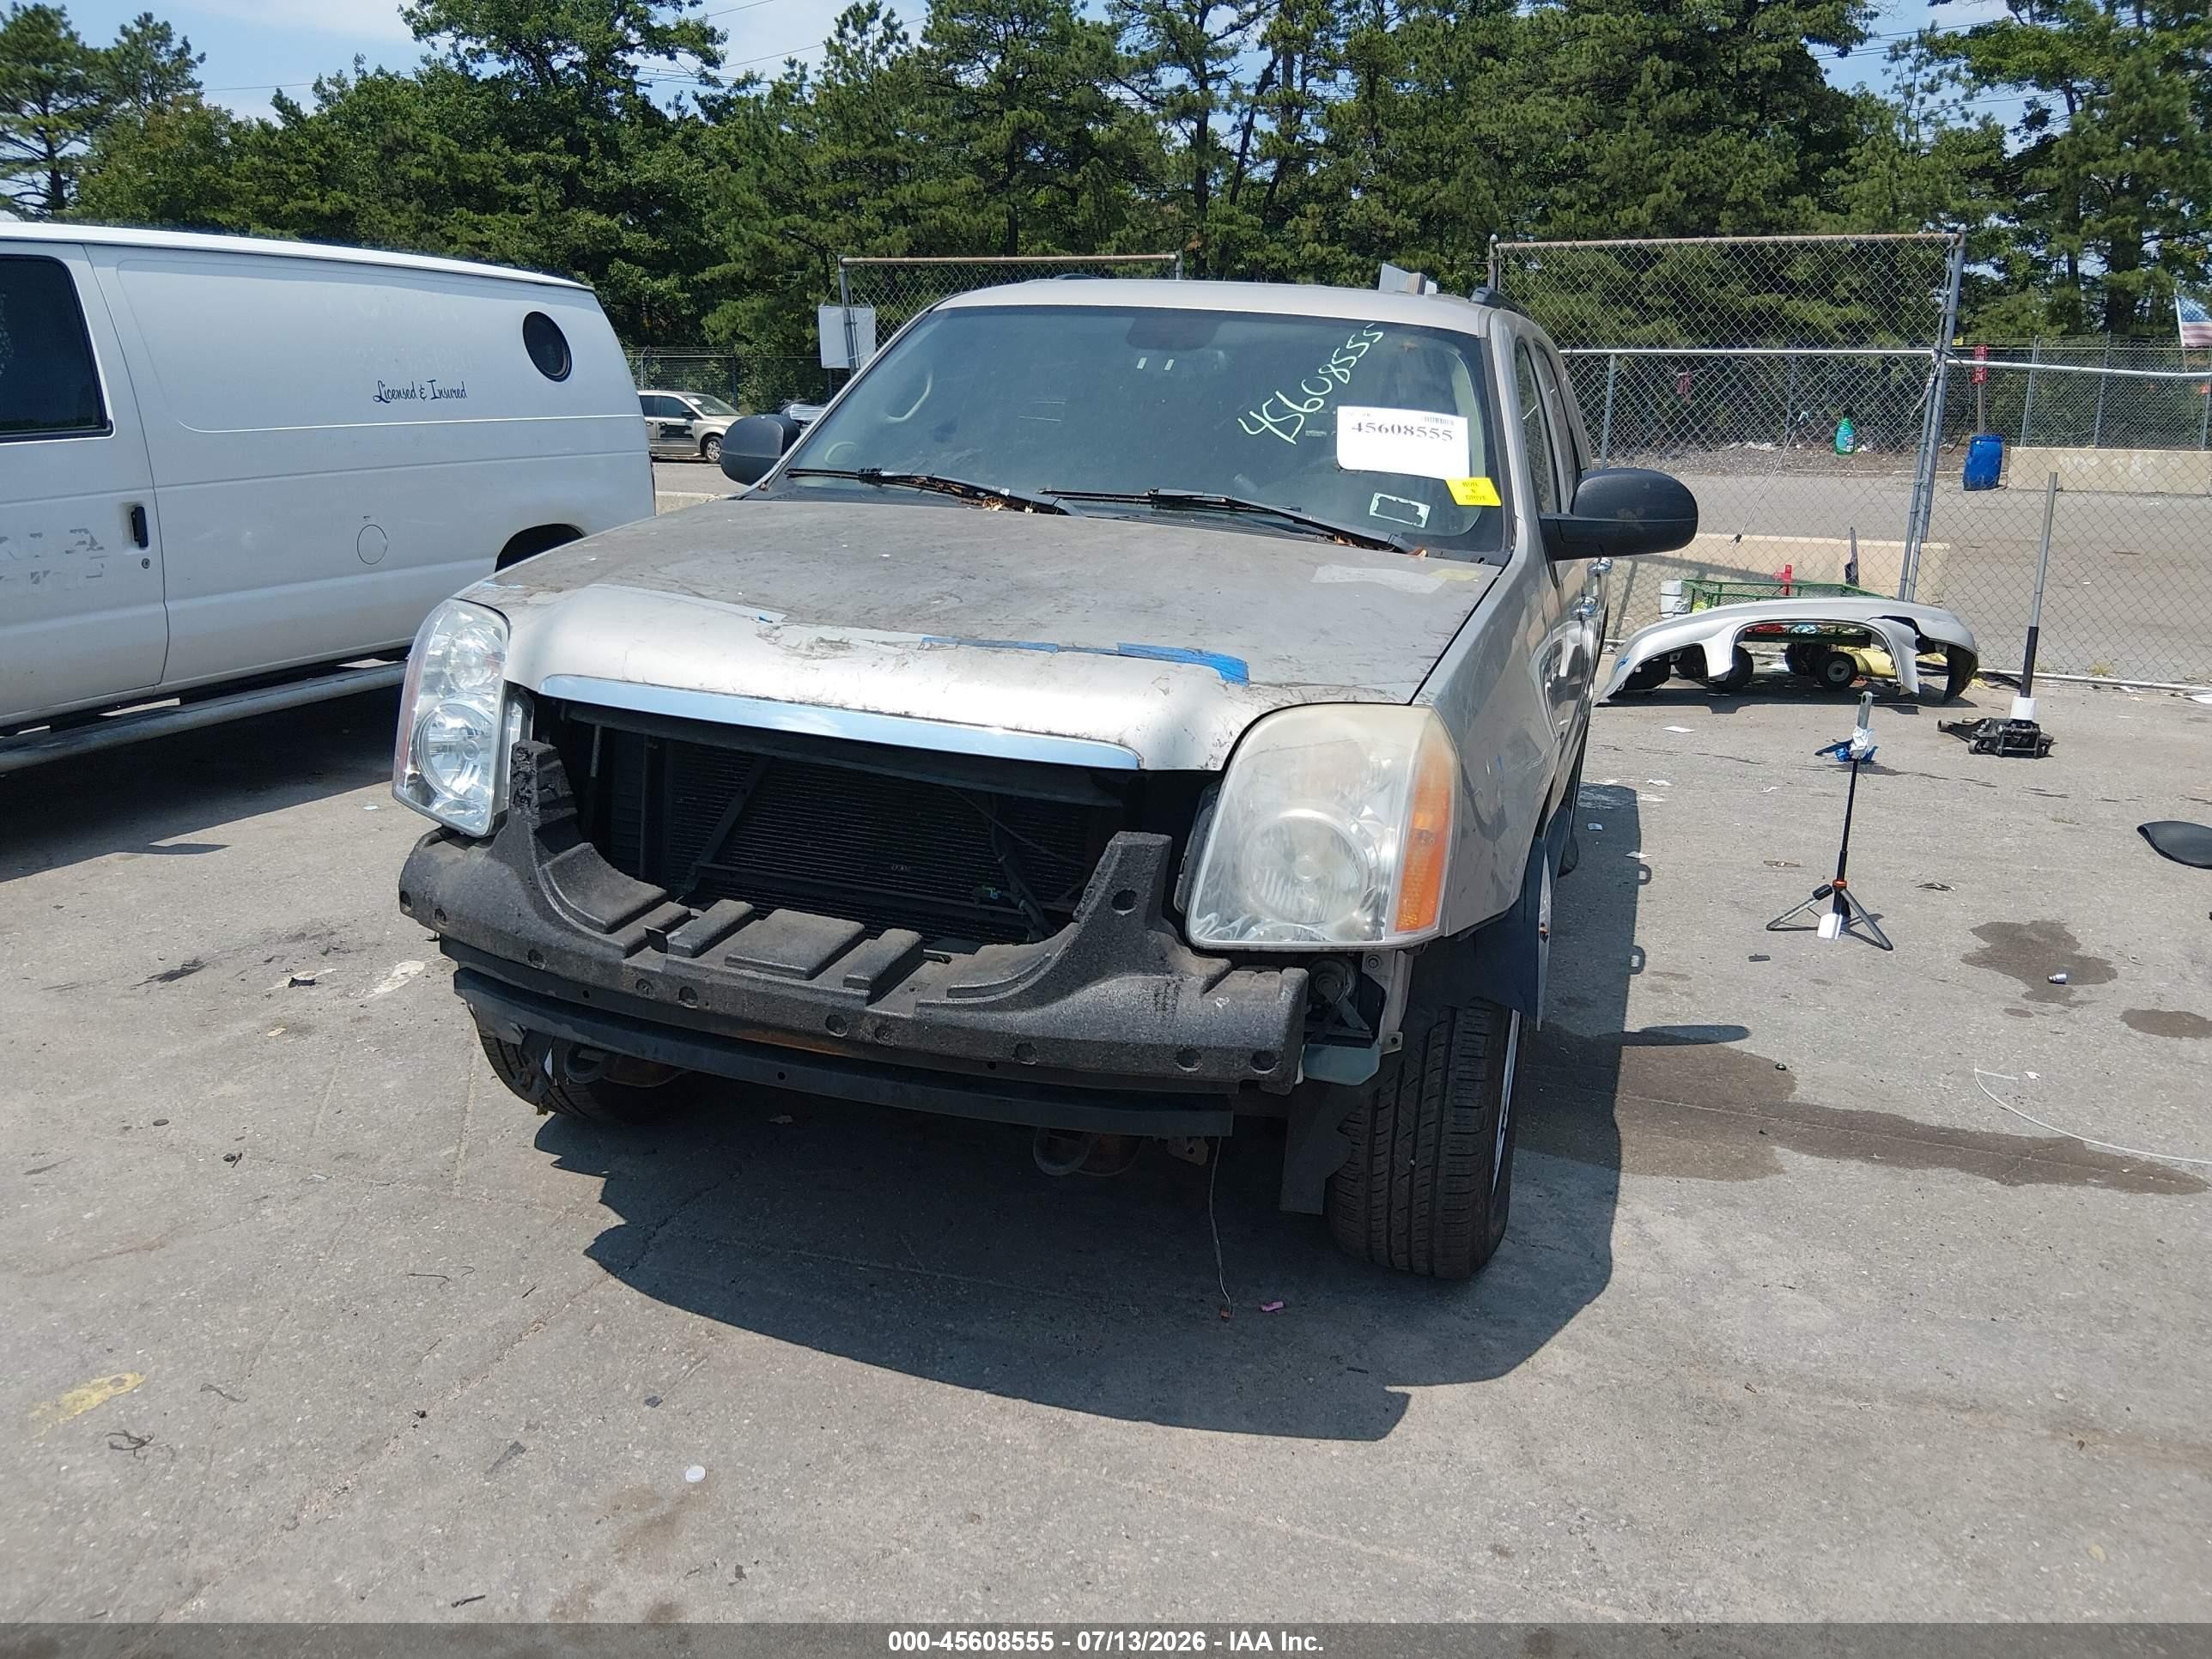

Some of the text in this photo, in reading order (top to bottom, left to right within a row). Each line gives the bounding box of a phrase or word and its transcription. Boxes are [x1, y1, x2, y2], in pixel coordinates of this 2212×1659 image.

[373, 380, 468, 403] Licensed & Insured
[1237, 323, 1384, 445] 45608555
[1352, 422, 1453, 441] 45608555
